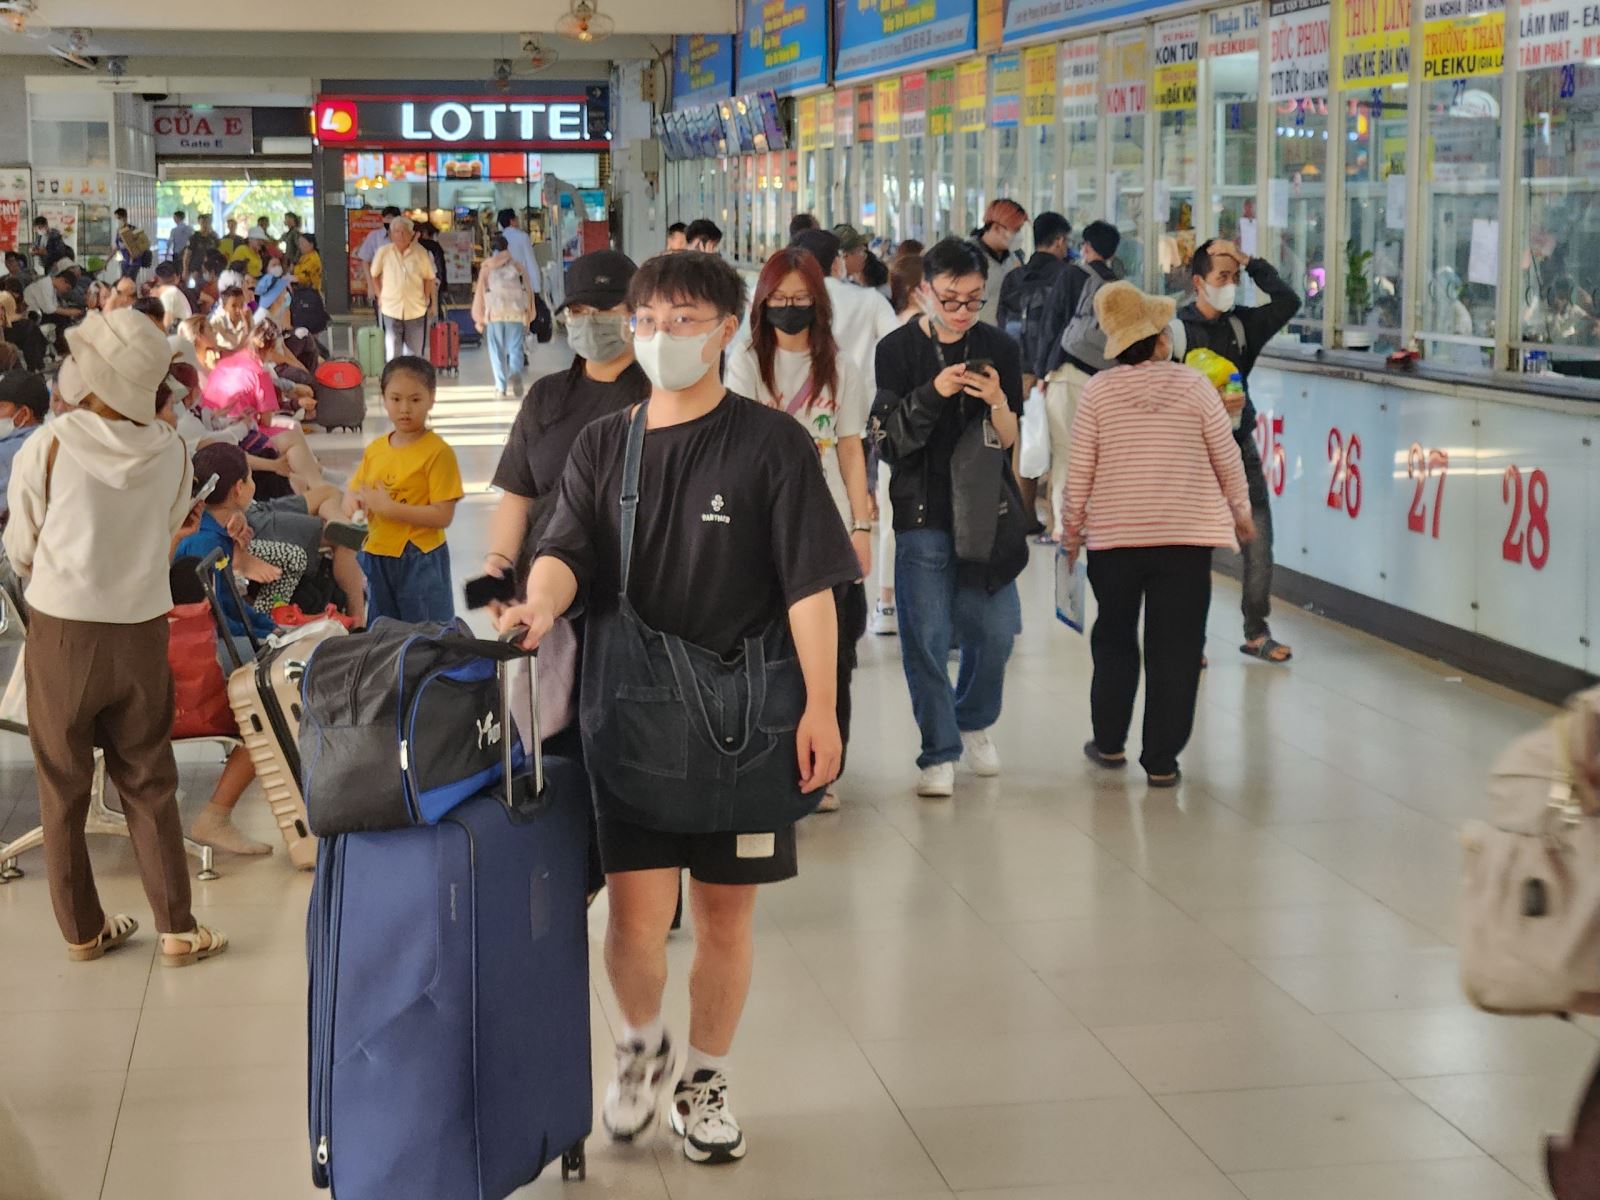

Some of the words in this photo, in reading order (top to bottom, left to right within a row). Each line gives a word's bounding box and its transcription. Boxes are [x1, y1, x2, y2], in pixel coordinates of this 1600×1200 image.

[1550, 11, 1568, 33] NHI
[1156, 45, 1177, 64] KON
[1424, 55, 1476, 77] PLEIKU
[1452, 79, 1467, 107] 27
[1559, 63, 1575, 98] 28
[223, 116, 242, 135] E
[180, 139, 210, 148] Gate
[214, 139, 223, 148] E
[1326, 427, 1362, 519] 26
[1407, 441, 1449, 540] 27
[1501, 463, 1550, 571] 28
